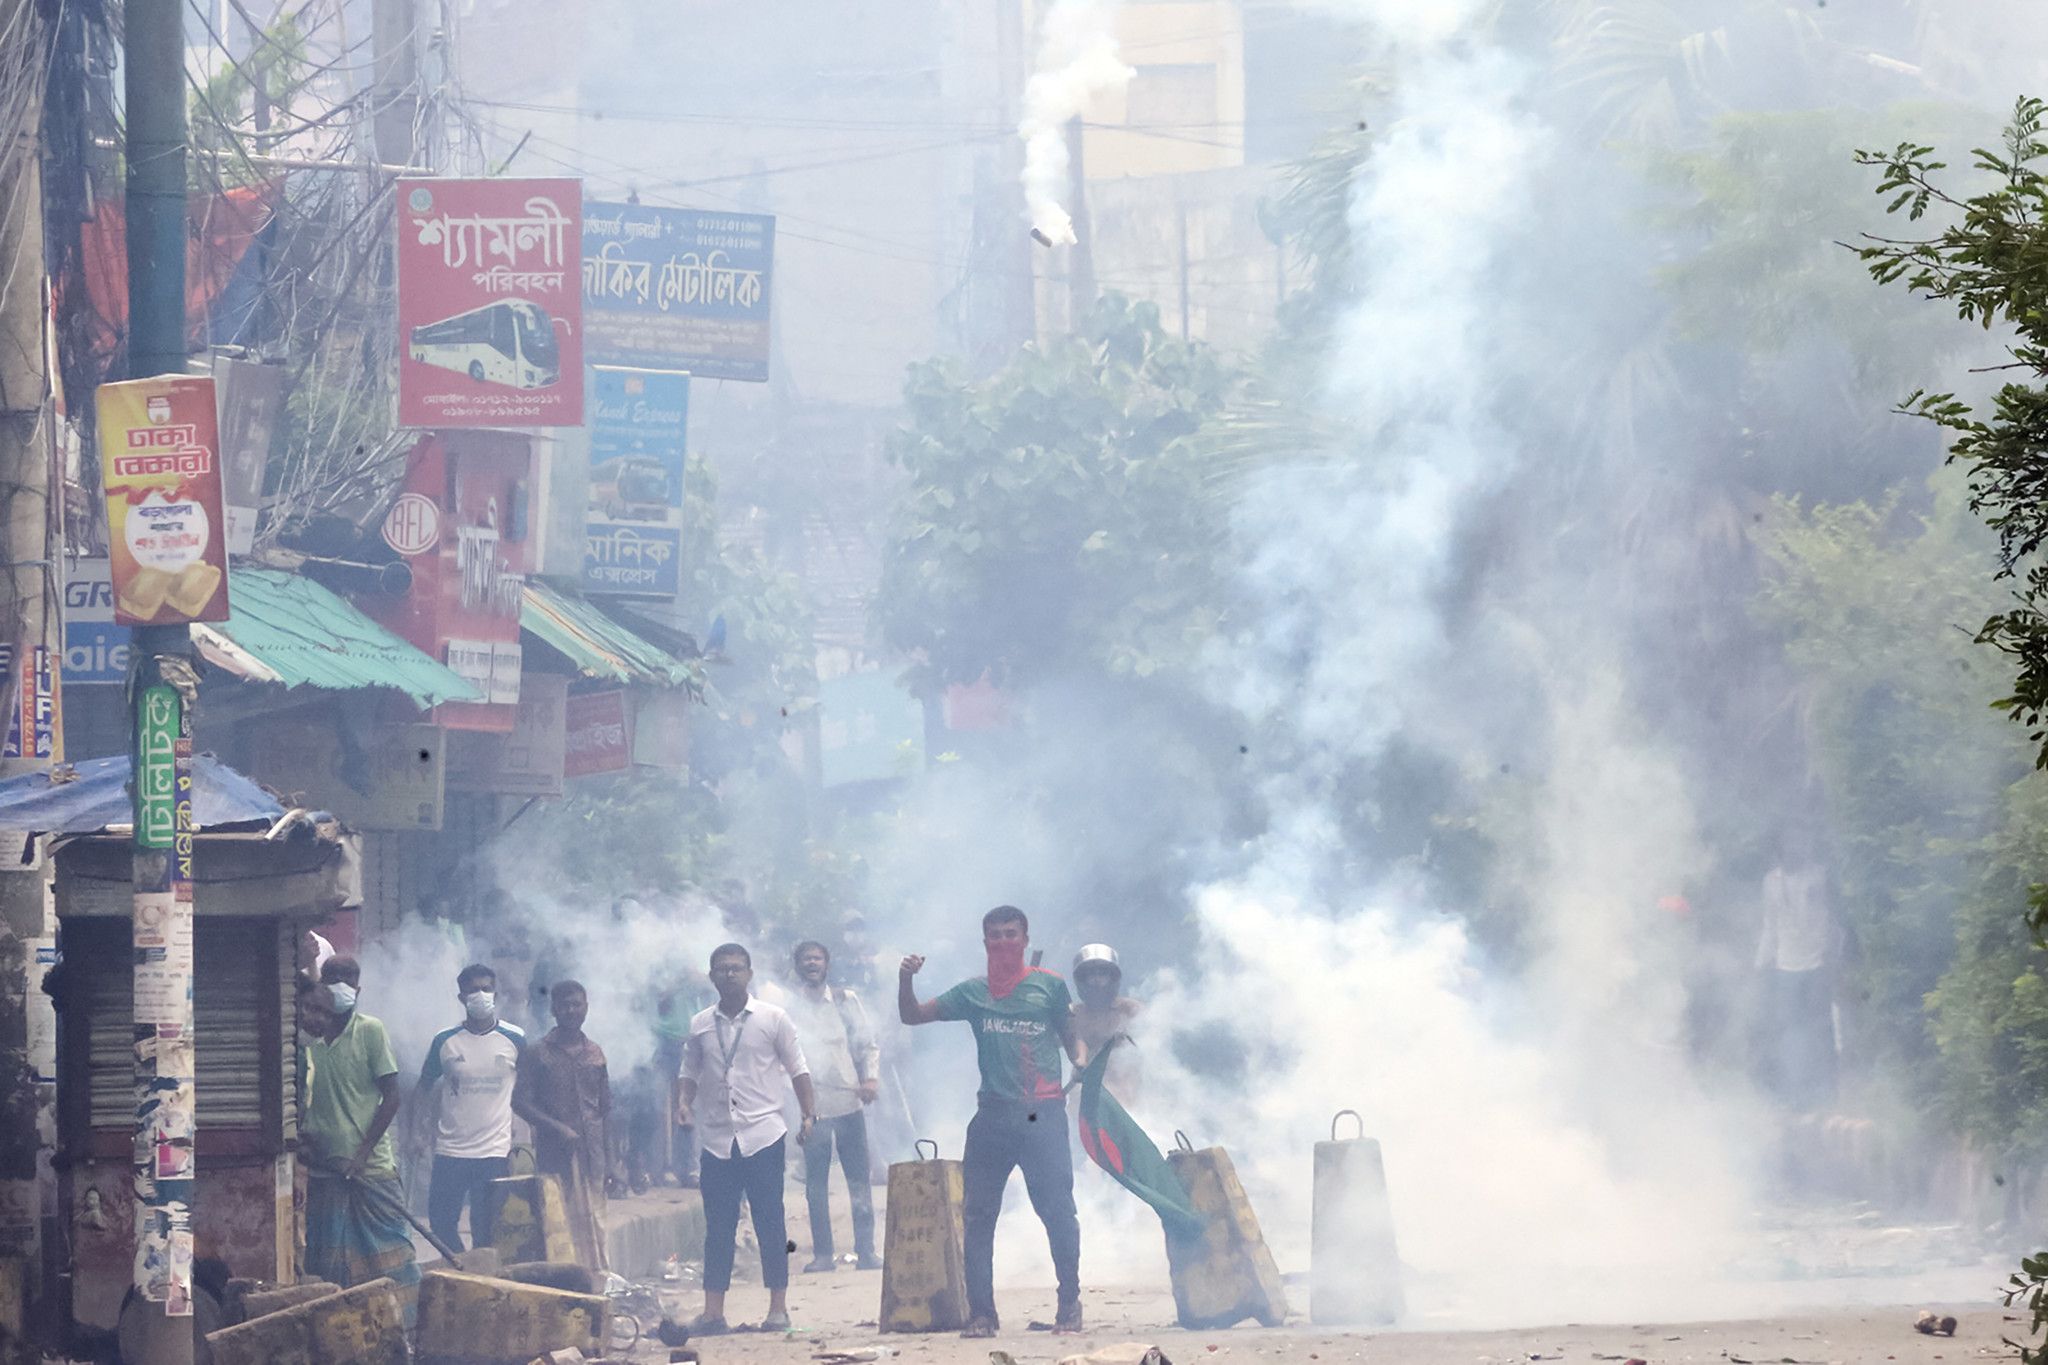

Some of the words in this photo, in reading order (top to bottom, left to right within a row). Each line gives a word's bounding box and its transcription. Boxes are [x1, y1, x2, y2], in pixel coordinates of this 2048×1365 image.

[413, 197, 572, 268] শ্যামলী
[472, 266, 565, 293] পরিবহন
[657, 250, 762, 311] মেটালিক
[127, 424, 196, 448] ঢাকা
[114, 445, 211, 478] বেকারী
[391, 501, 432, 549] RFL
[586, 528, 673, 566] মানিক
